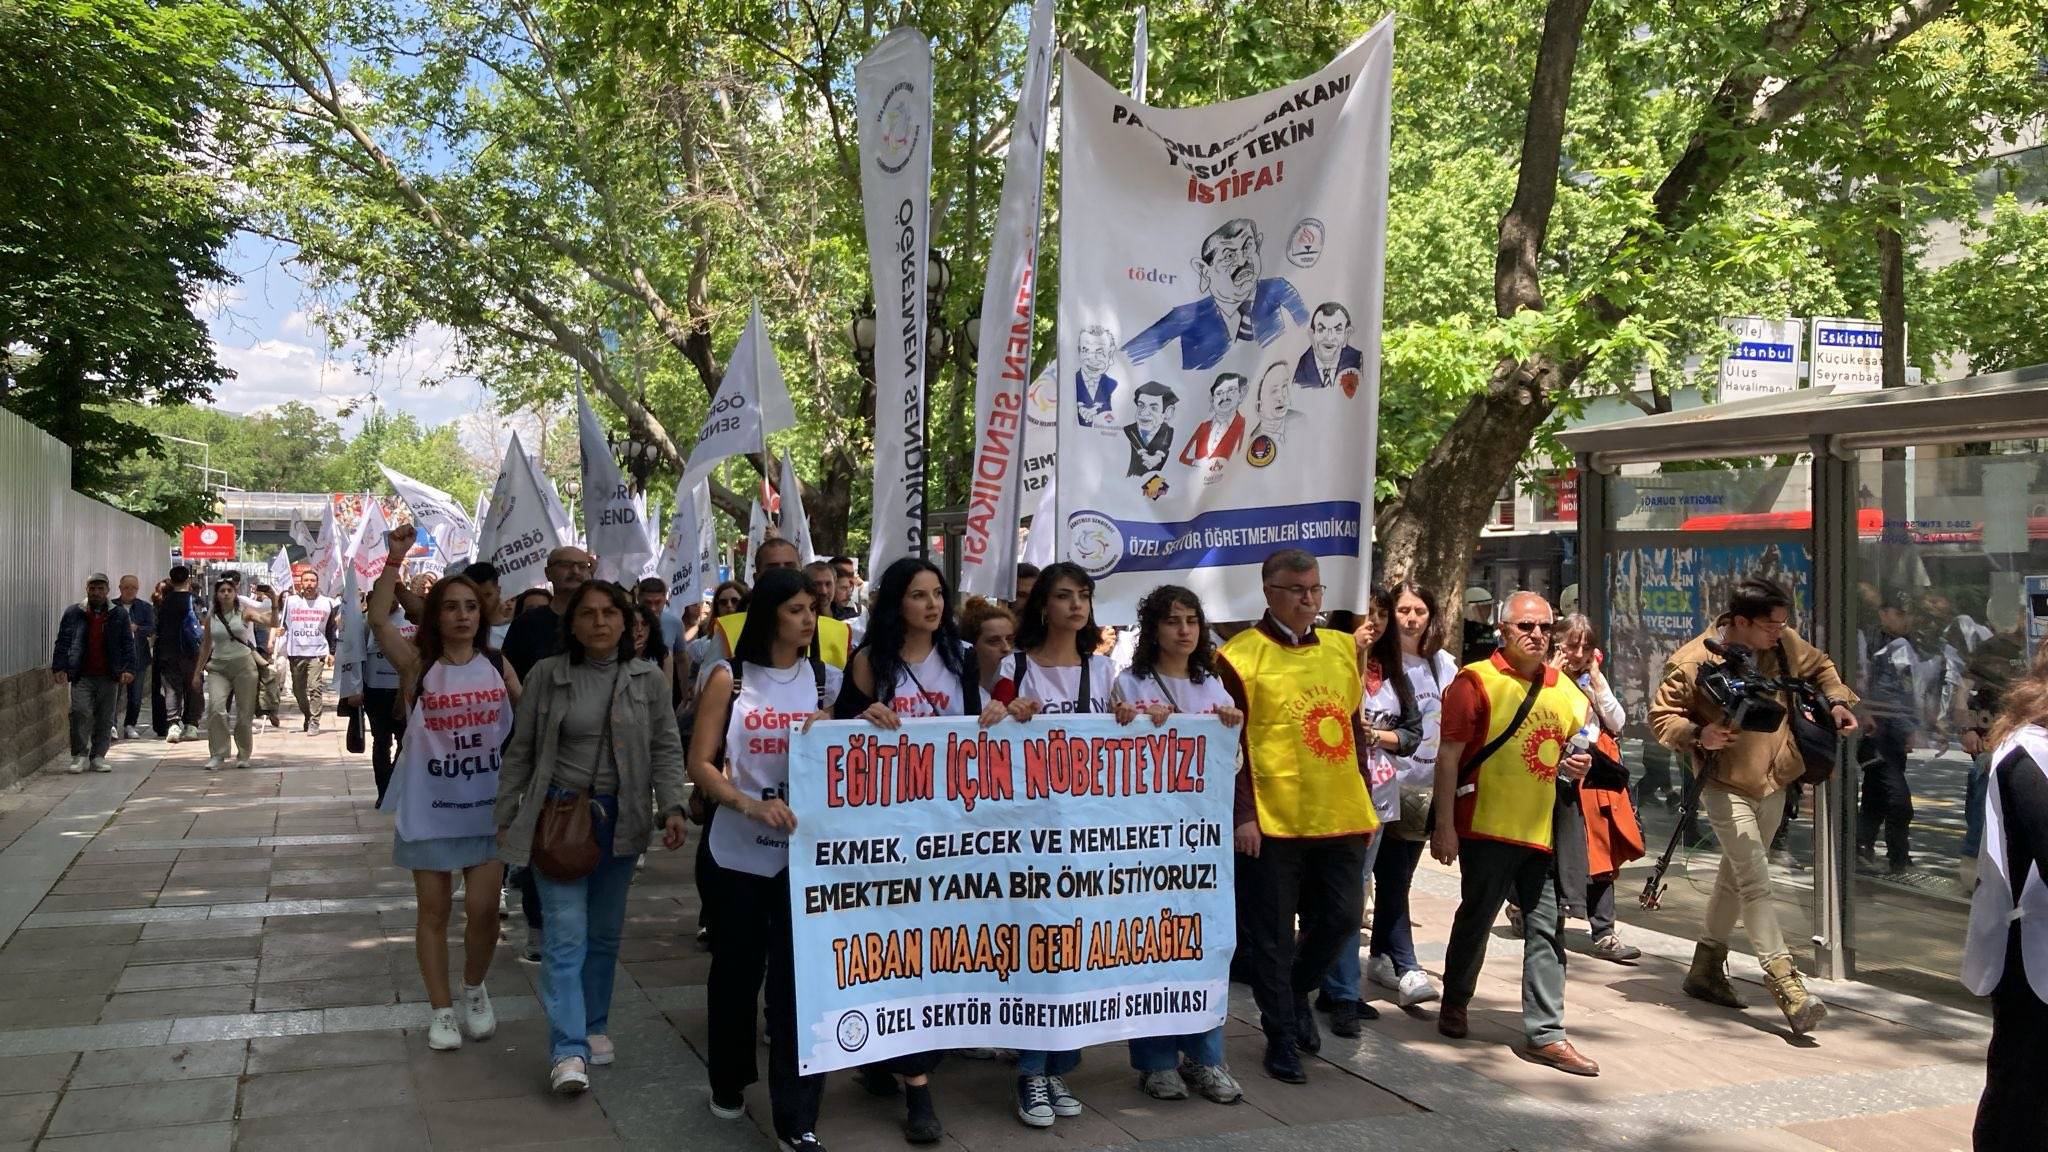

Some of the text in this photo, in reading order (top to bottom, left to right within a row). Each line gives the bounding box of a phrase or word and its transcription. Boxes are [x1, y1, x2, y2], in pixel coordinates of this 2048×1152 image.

[1243, 118, 1315, 159] TEKİN
[1187, 160, 1284, 204] İSTİFA!
[1128, 265, 1177, 285] töder
[1726, 365, 1757, 378] Ulus
[1817, 352, 1882, 365] Küçükesa
[1129, 536, 1160, 556] ÖZEL
[1204, 520, 1299, 548] ÖĞRETMENLERİ
[453, 731, 483, 751] İLE
[428, 748, 500, 781] GÜÇLÜ
[826, 728, 1207, 812] EĞİTİM İÇİN NÖBETTEYİZ!
[815, 818, 1222, 866] EKMEK, GELECEK VE MEMLEKET İÇİN
[804, 860, 1218, 914] EMEKTEN YANA BİR ÖMK İSTİYORUZ!
[832, 908, 1203, 990] TABAN MAAŞI GERİ ALACAĞIZ!
[876, 1006, 915, 1037] ÖZEL
[922, 998, 991, 1029] SEKTÖR
[999, 991, 1120, 1028] ÖĞRETMENLERİ
[1125, 986, 1207, 1019] SENDİKASI
